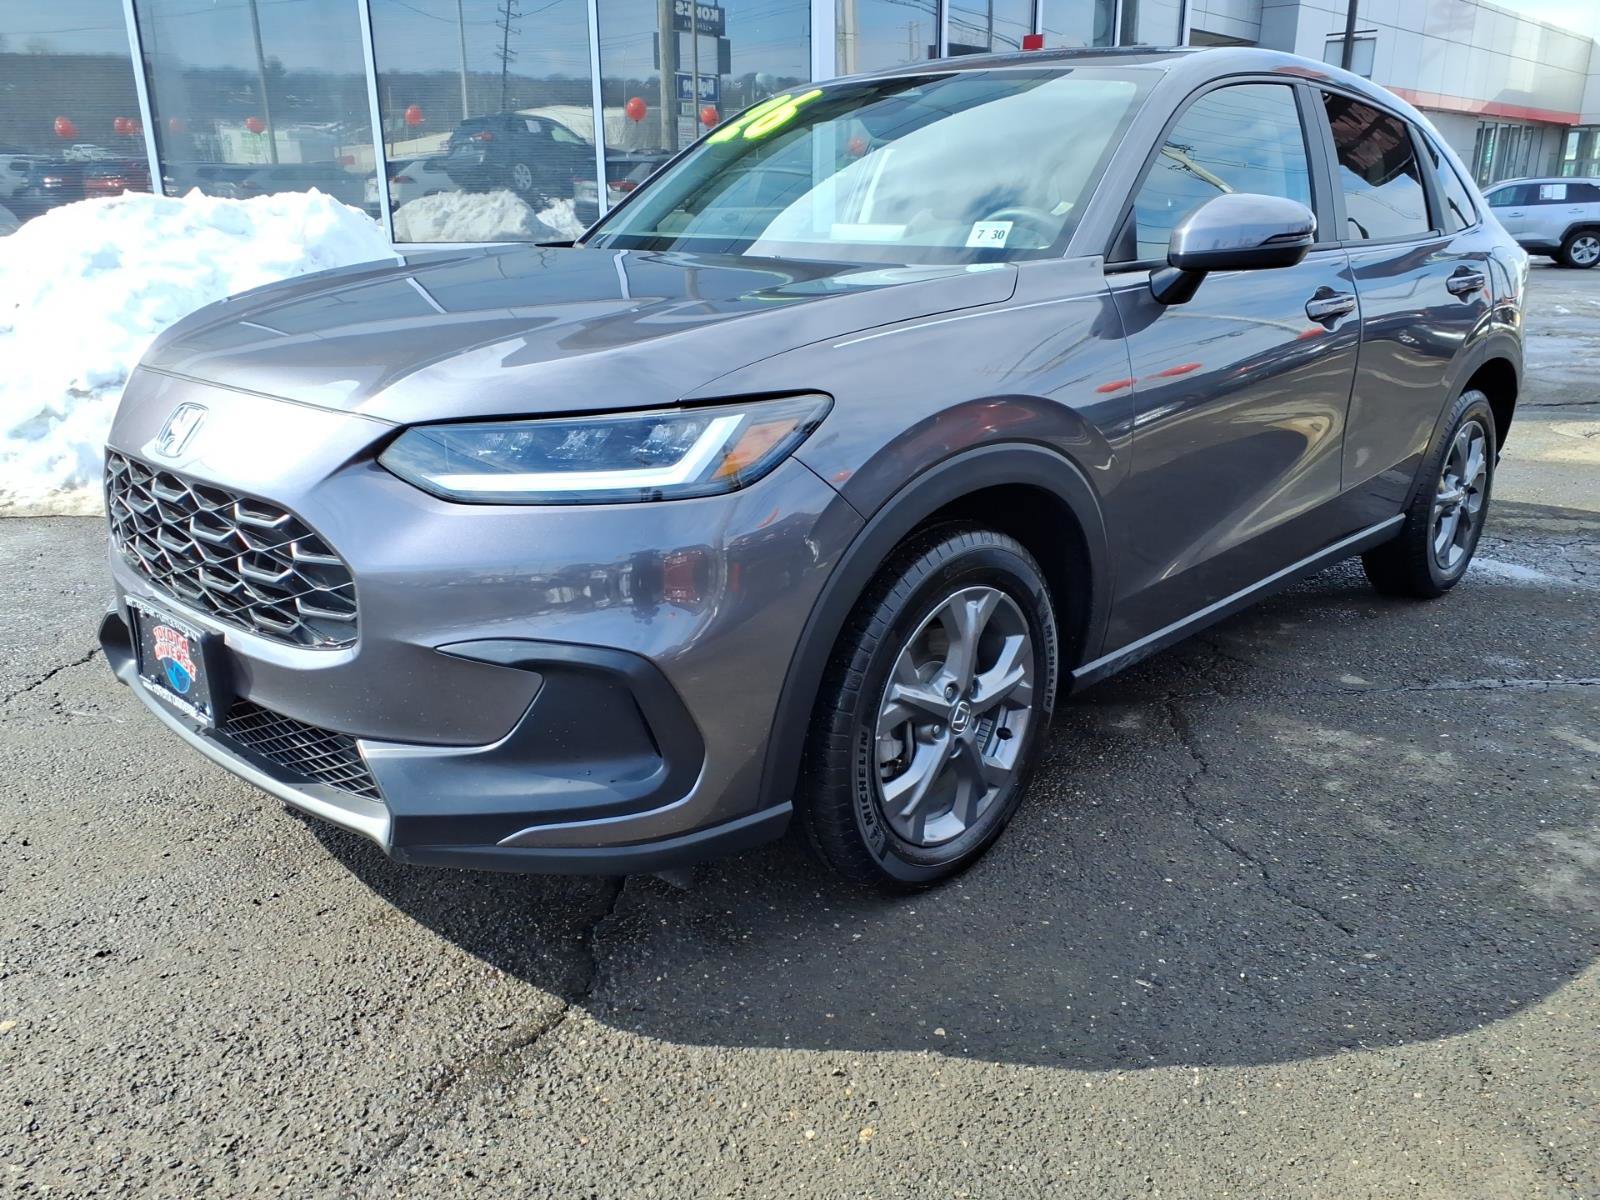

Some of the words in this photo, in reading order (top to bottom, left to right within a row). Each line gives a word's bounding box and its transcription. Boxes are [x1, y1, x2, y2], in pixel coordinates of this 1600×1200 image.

[977, 229, 985, 240] 7
[991, 229, 1006, 240] 30
[153, 625, 190, 659] TOYOTA
[858, 731, 874, 826] MICHELIN
